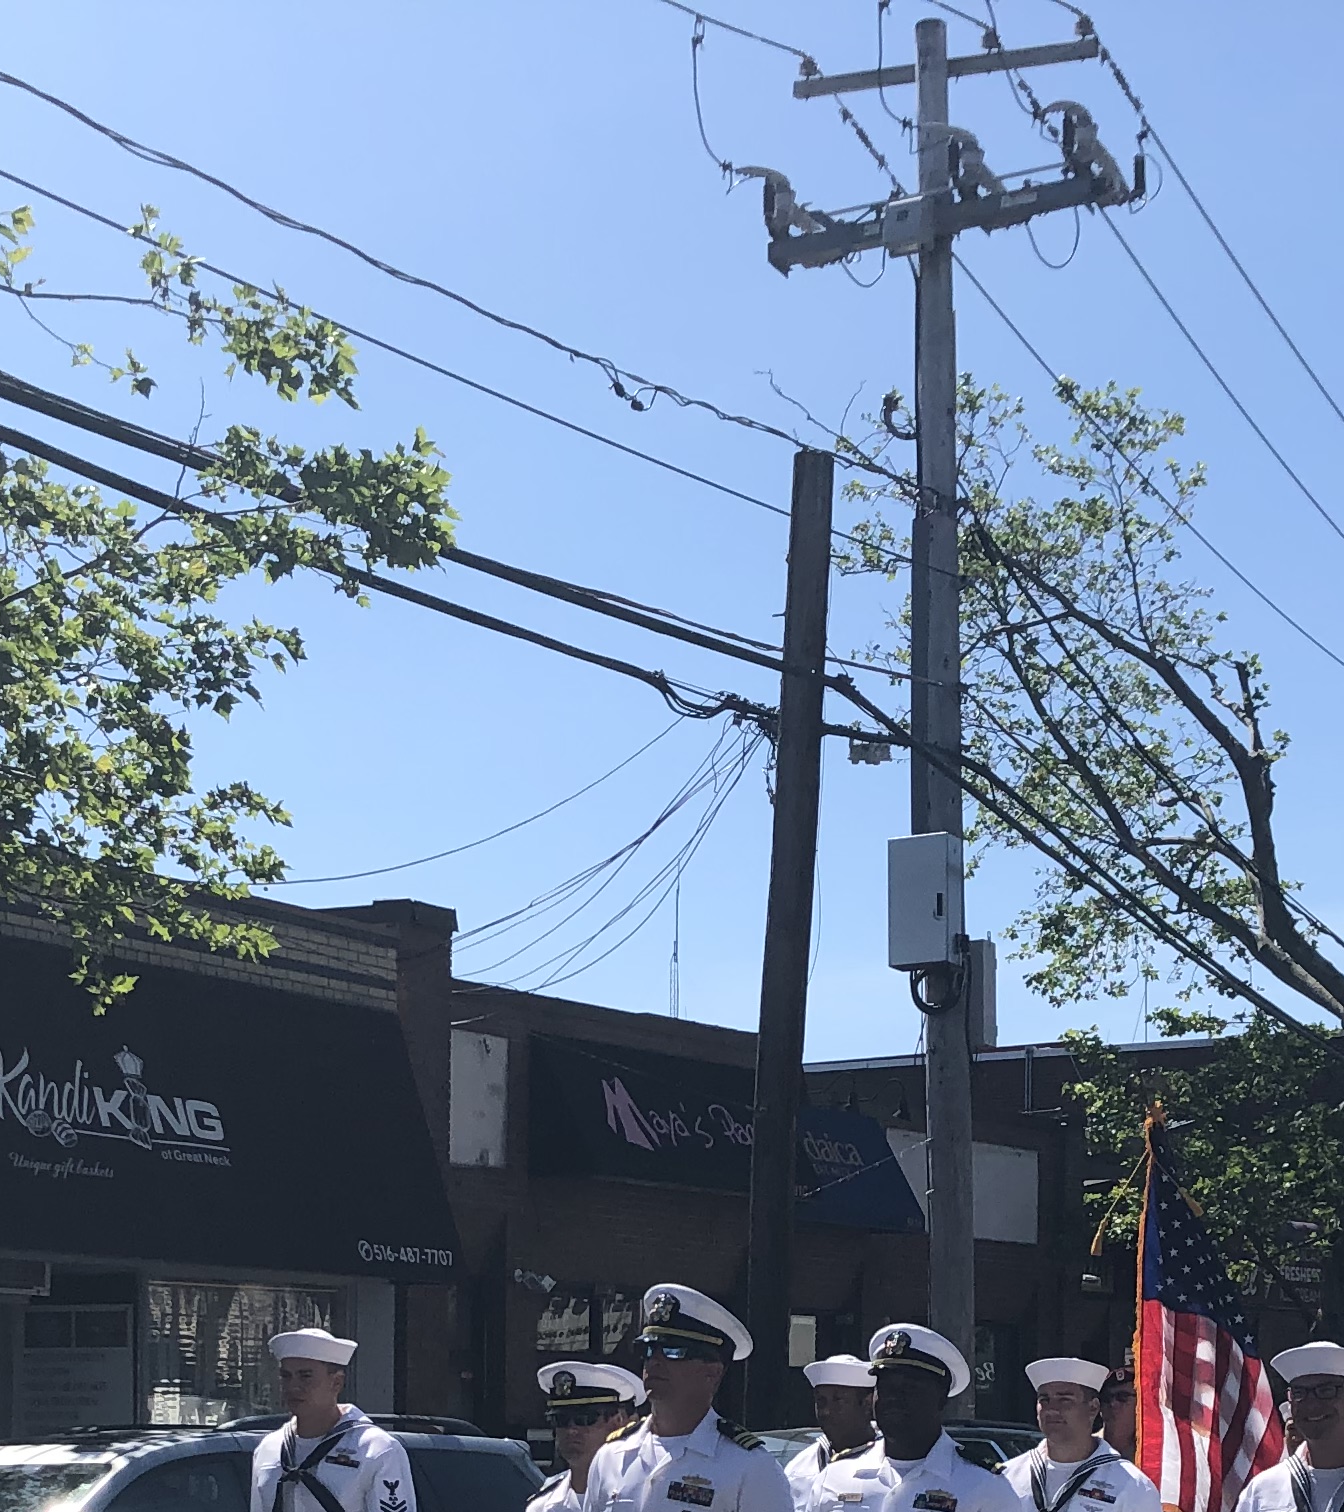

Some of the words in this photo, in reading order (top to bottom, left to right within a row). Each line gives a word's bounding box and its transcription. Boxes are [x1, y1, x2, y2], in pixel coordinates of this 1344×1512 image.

[9, 1152, 52, 1176] Unique
[52, 1157, 75, 1179] gift
[75, 1159, 114, 1178] baskets
[173, 1149, 204, 1164] Great
[203, 1152, 232, 1167] Neck
[373, 1244, 453, 1267] 516-487-7707
